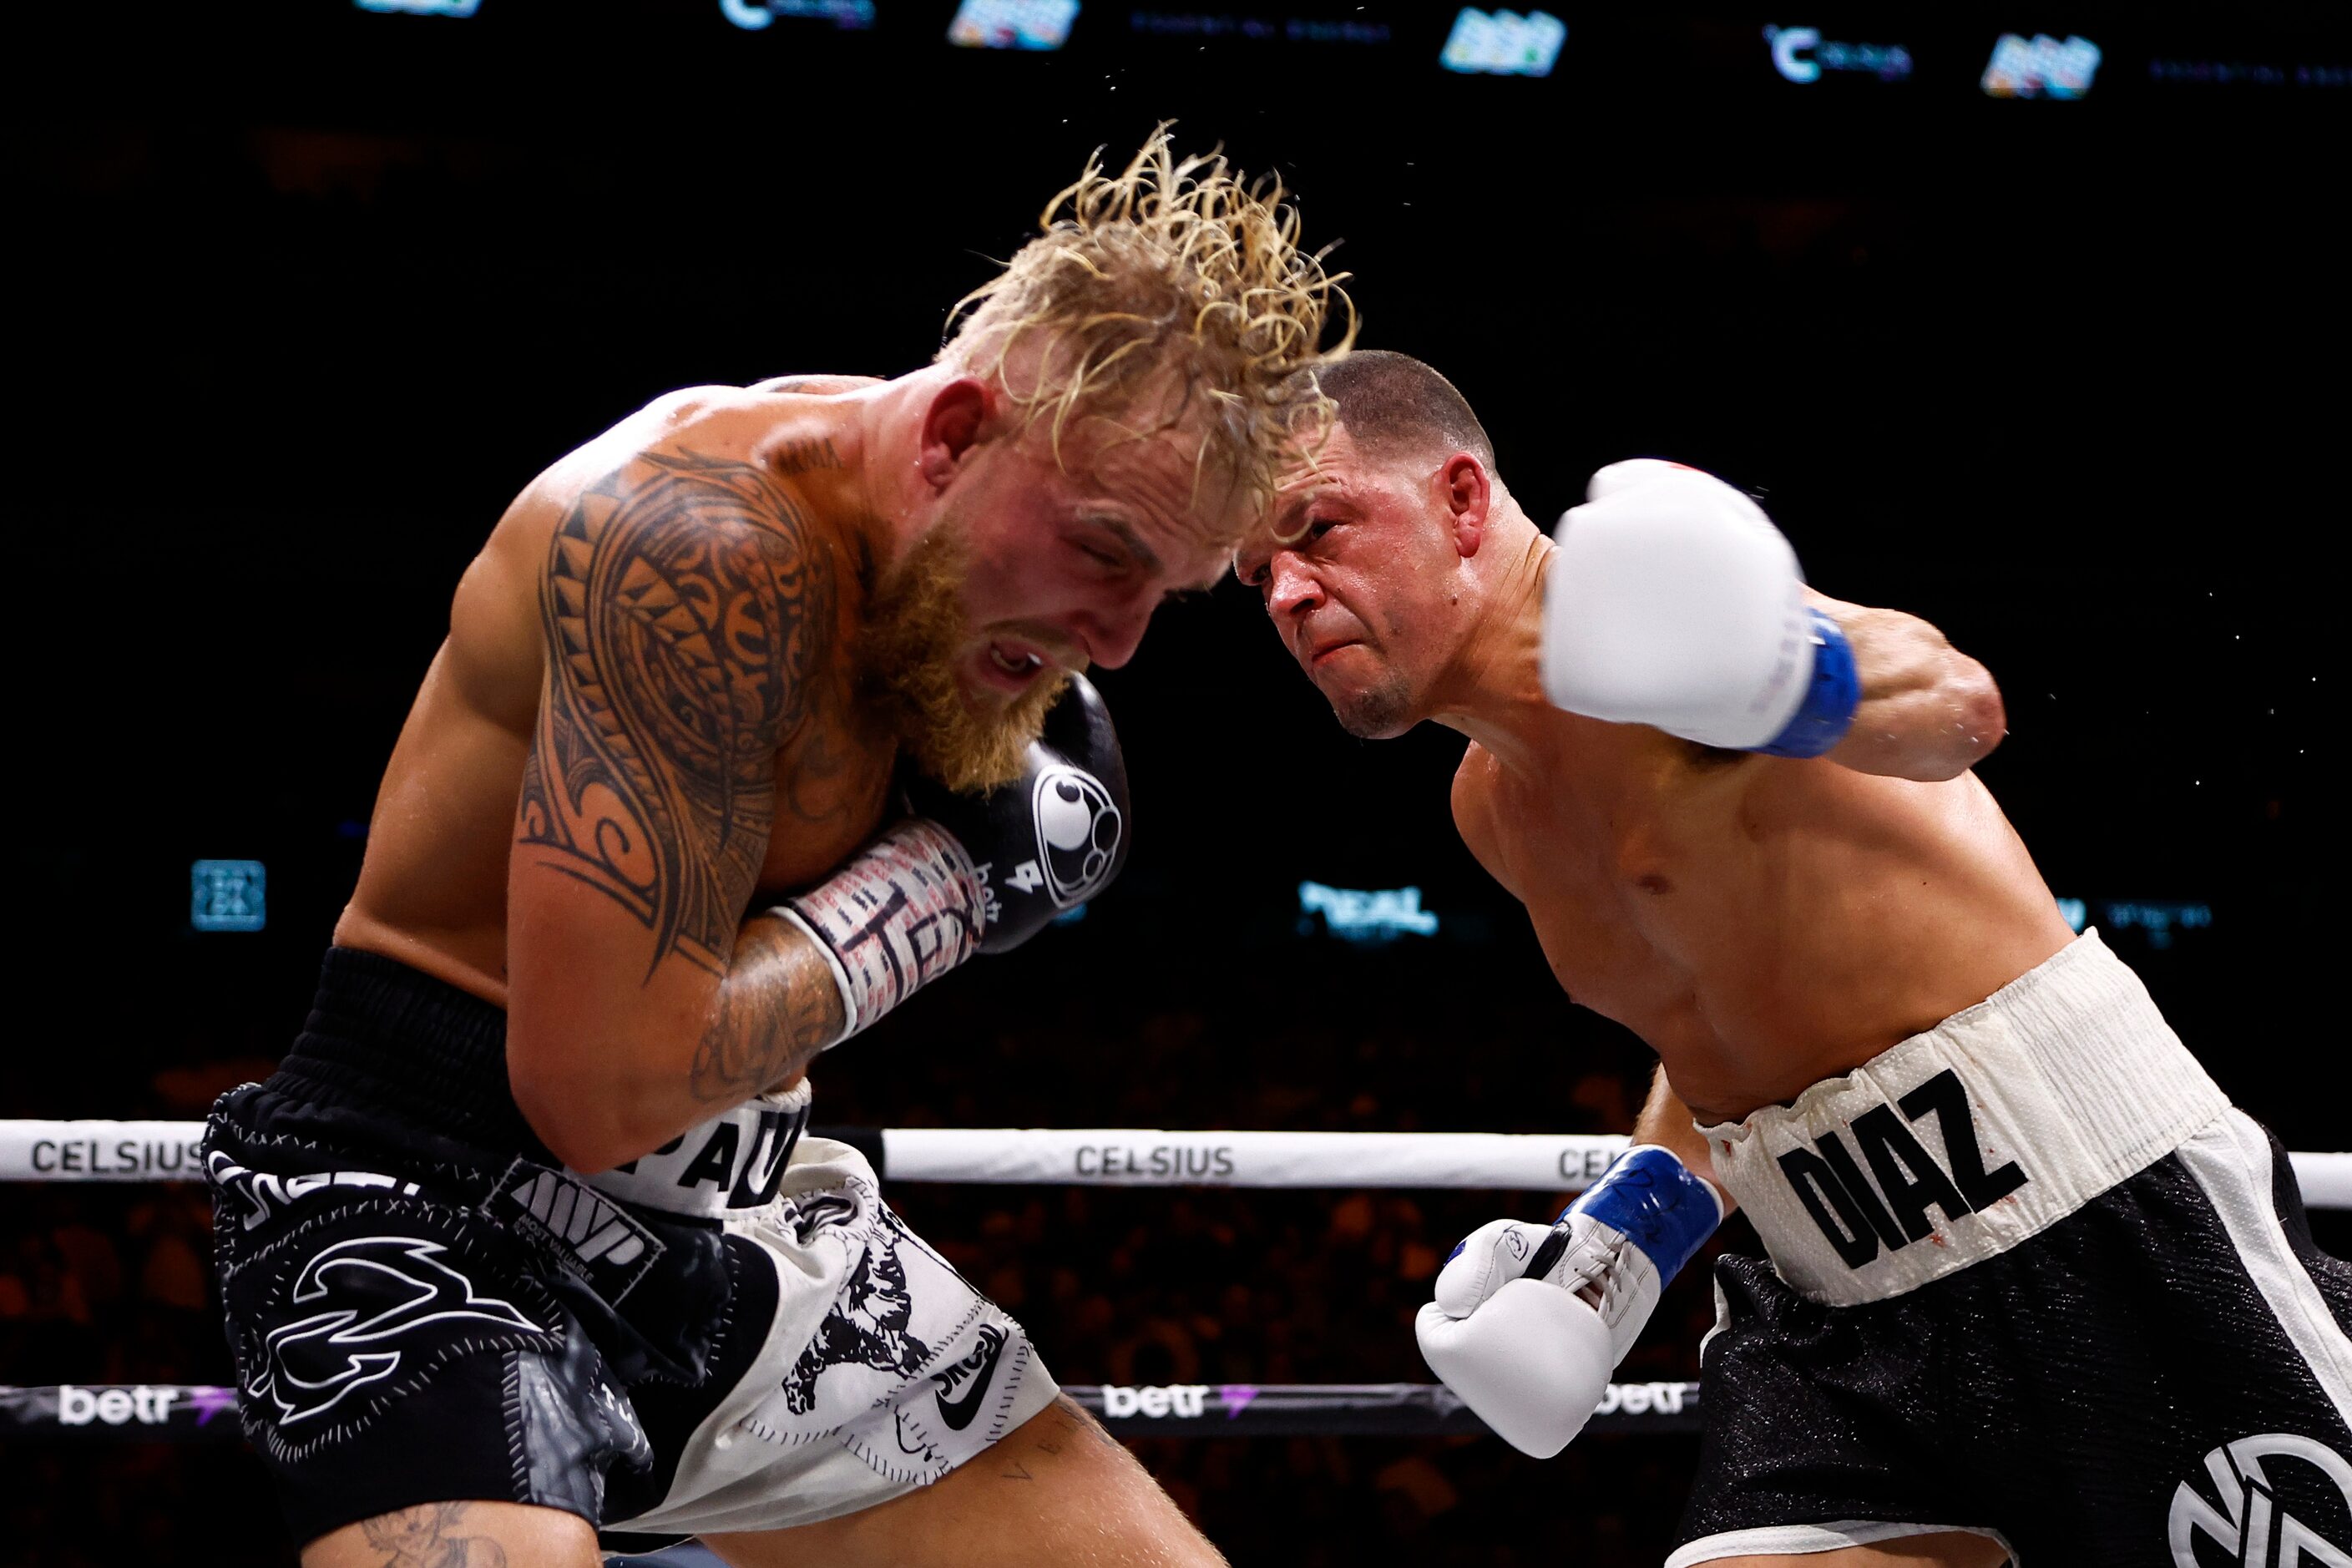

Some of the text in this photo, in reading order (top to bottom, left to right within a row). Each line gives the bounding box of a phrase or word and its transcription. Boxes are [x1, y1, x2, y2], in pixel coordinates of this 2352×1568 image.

[33, 1141, 203, 1173] CELSIUS
[1075, 1146, 1234, 1176] CELSIUS
[1778, 1069, 2029, 1269] DIAZ
[518, 1213, 550, 1242] MOST
[58, 1384, 180, 1424] betr
[1101, 1383, 1211, 1418] betr
